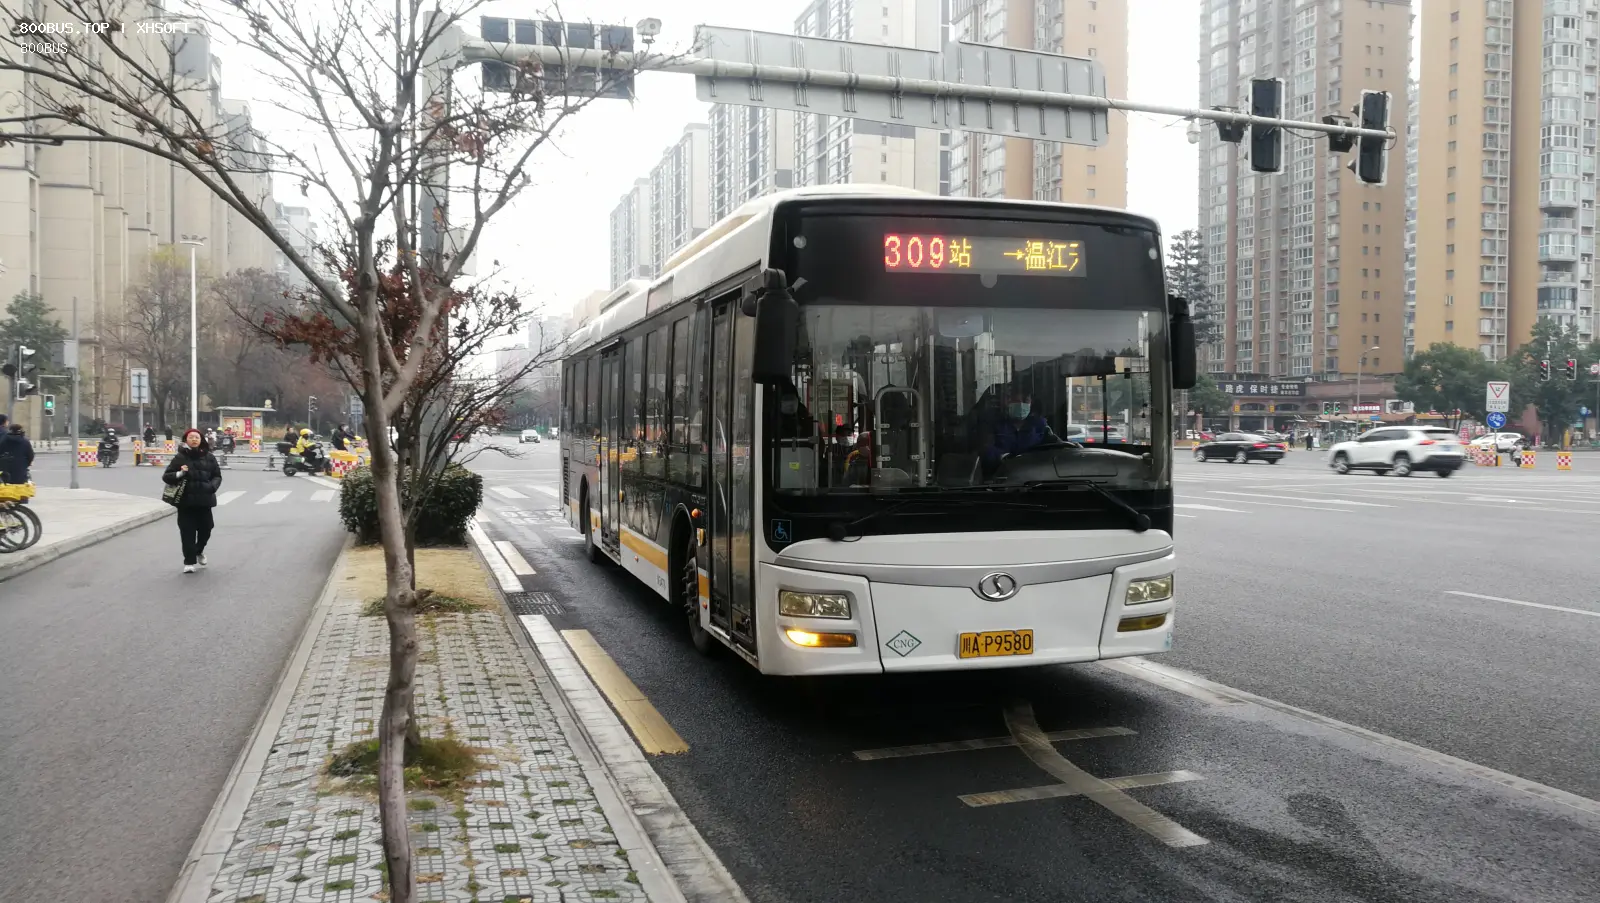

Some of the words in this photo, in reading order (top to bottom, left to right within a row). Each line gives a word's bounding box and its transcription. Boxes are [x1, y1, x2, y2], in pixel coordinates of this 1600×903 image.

[1225, 384, 1244, 394] 路虎
[1250, 384, 1279, 394] 保时捷
[893, 638, 915, 649] CNG
